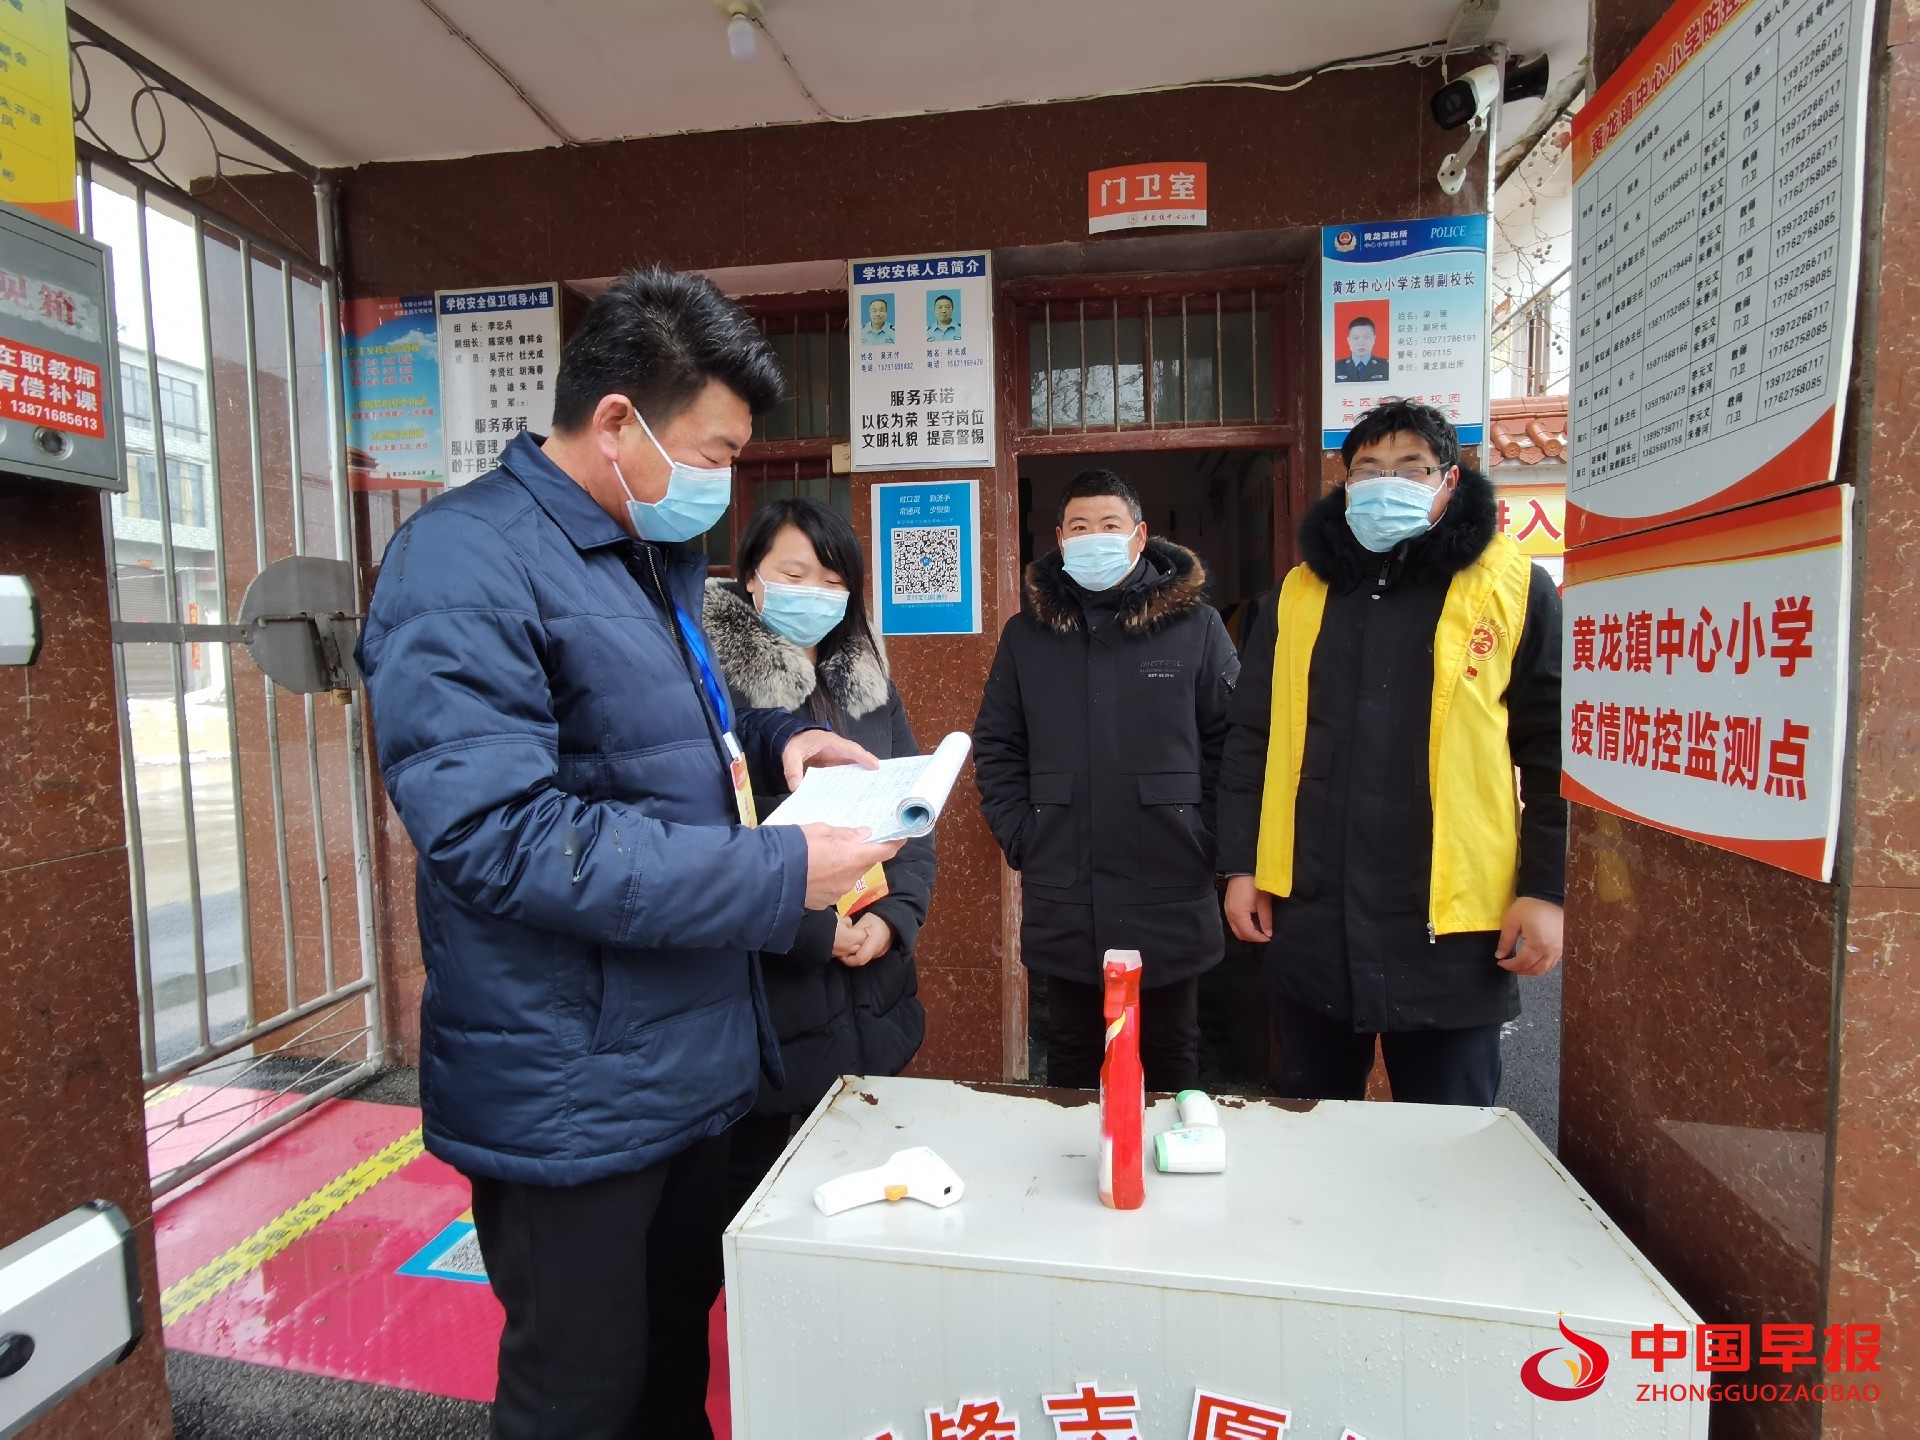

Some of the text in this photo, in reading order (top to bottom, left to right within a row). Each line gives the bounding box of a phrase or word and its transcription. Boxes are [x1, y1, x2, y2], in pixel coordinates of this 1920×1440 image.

[1704, 22, 1844, 156] 李元文 教师 13972266717
[1744, 120, 1759, 140] 门卫
[1782, 43, 1842, 105] 17762758085
[1702, 80, 1840, 201] 李元文 教师 13972266717
[1742, 168, 1757, 189] 门卫
[1780, 101, 1839, 156] 17762758085
[1101, 172, 1195, 207] 门卫室
[1700, 135, 1838, 247] 李元文 教师 13972266717
[1740, 217, 1755, 237] 门卫
[1779, 156, 1837, 207] 17762758085
[1364, 225, 1466, 241] 黄龙派出所 POLICE
[1697, 191, 1836, 291] 李元文 教师 13972266717
[1737, 266, 1752, 284] 门卫
[1776, 211, 1835, 258] 17762758085
[862, 260, 979, 280] 学校安保人员简介
[1332, 272, 1475, 295] 黄龙中心小学法制副校长
[1694, 246, 1833, 336] 李元文 教师 13972266717
[446, 292, 549, 311] 学校安全保卫领导小组
[1734, 314, 1749, 331] 门卫
[1772, 266, 1832, 308] 17762758085
[454, 324, 461, 333] 组
[519, 334, 543, 344] 曾祥金
[1691, 301, 1829, 381] 李元文 教师 13972266717
[0, 345, 95, 388] 在职教师
[490, 365, 543, 377] 李贤红 胡海春
[519, 349, 544, 360] 杜光成
[1730, 363, 1745, 380] 门卫
[1769, 321, 1827, 359] 17762758085
[0, 370, 97, 412] 有偿补课
[891, 388, 954, 406] 服务承诺
[1689, 355, 1824, 424] 李元文 教师 13972266717
[1726, 410, 1741, 426] 门卫
[1764, 376, 1822, 408] 17762758085
[11, 400, 97, 430] 13871685613
[475, 417, 528, 433] 服务承诺
[862, 409, 984, 430] 以校为荣 坚守岗位
[451, 439, 498, 455] 服从管理
[862, 432, 918, 448] 文明礼貌
[452, 458, 499, 473] 敢于担当
[1572, 595, 1813, 677] 黄龙镇中心小学
[1571, 700, 1809, 801] 疫情防控监测点
